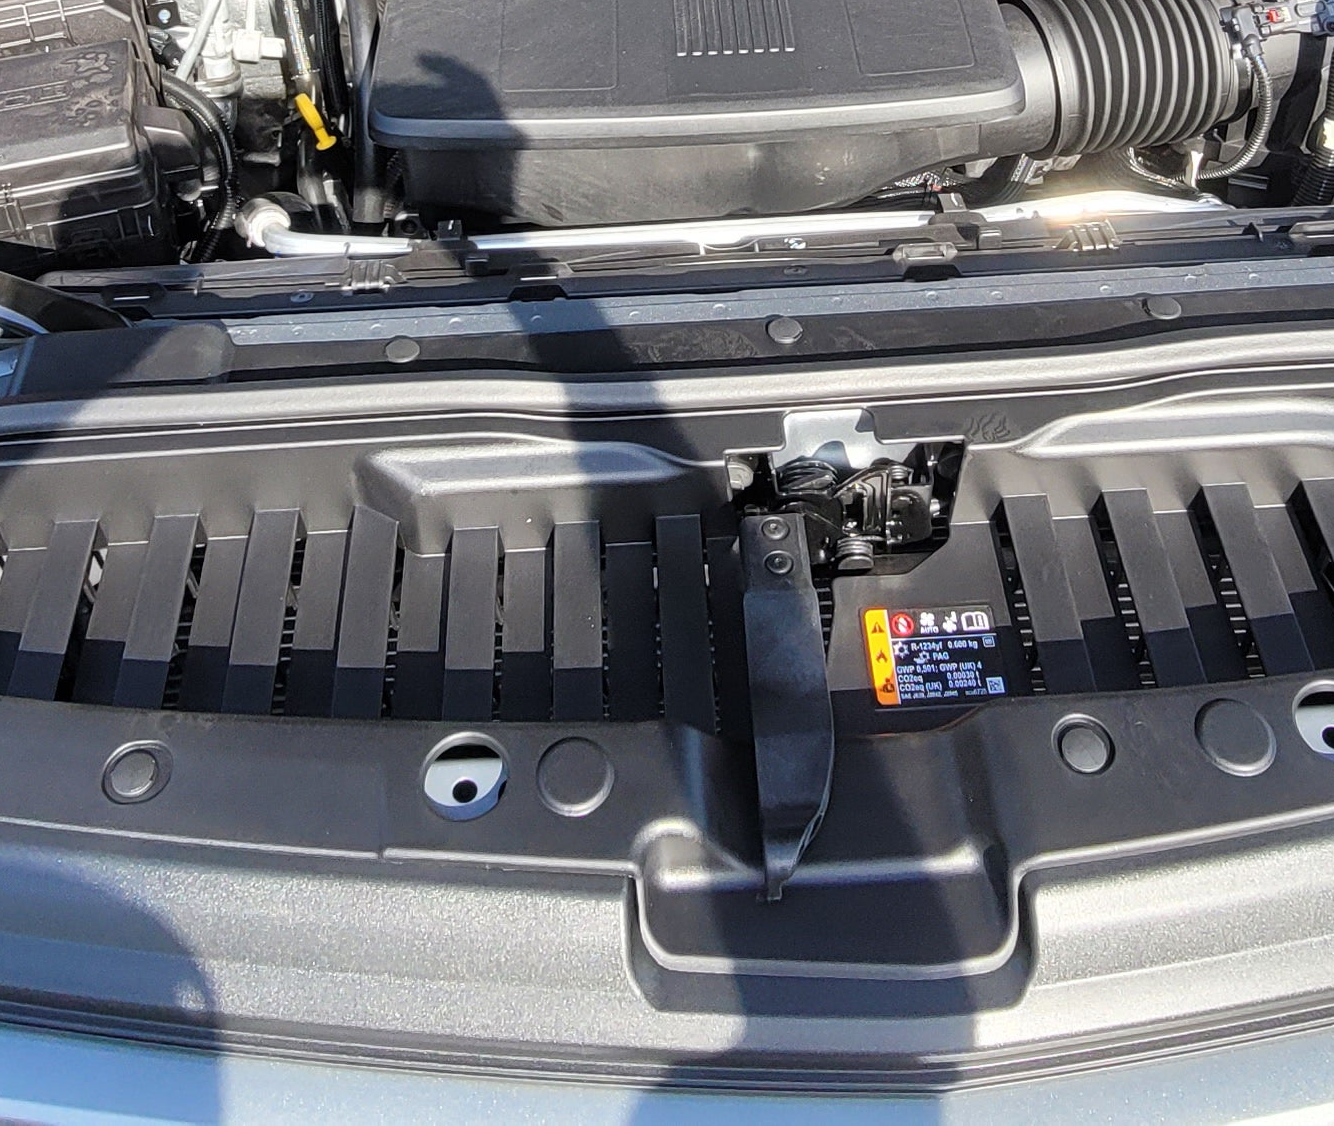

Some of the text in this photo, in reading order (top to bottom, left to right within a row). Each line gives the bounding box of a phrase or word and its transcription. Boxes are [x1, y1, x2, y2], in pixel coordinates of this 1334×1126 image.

[920, 626, 939, 634] AUTO
[911, 641, 943, 651] R-1234yf
[968, 640, 978, 649] kg
[896, 666, 915, 674] GWP
[939, 663, 958, 672] GWP
[959, 662, 976, 671] (UK)
[976, 661, 982, 669] 4
[898, 675, 924, 683] CO2eq
[925, 682, 943, 691] (UK)
